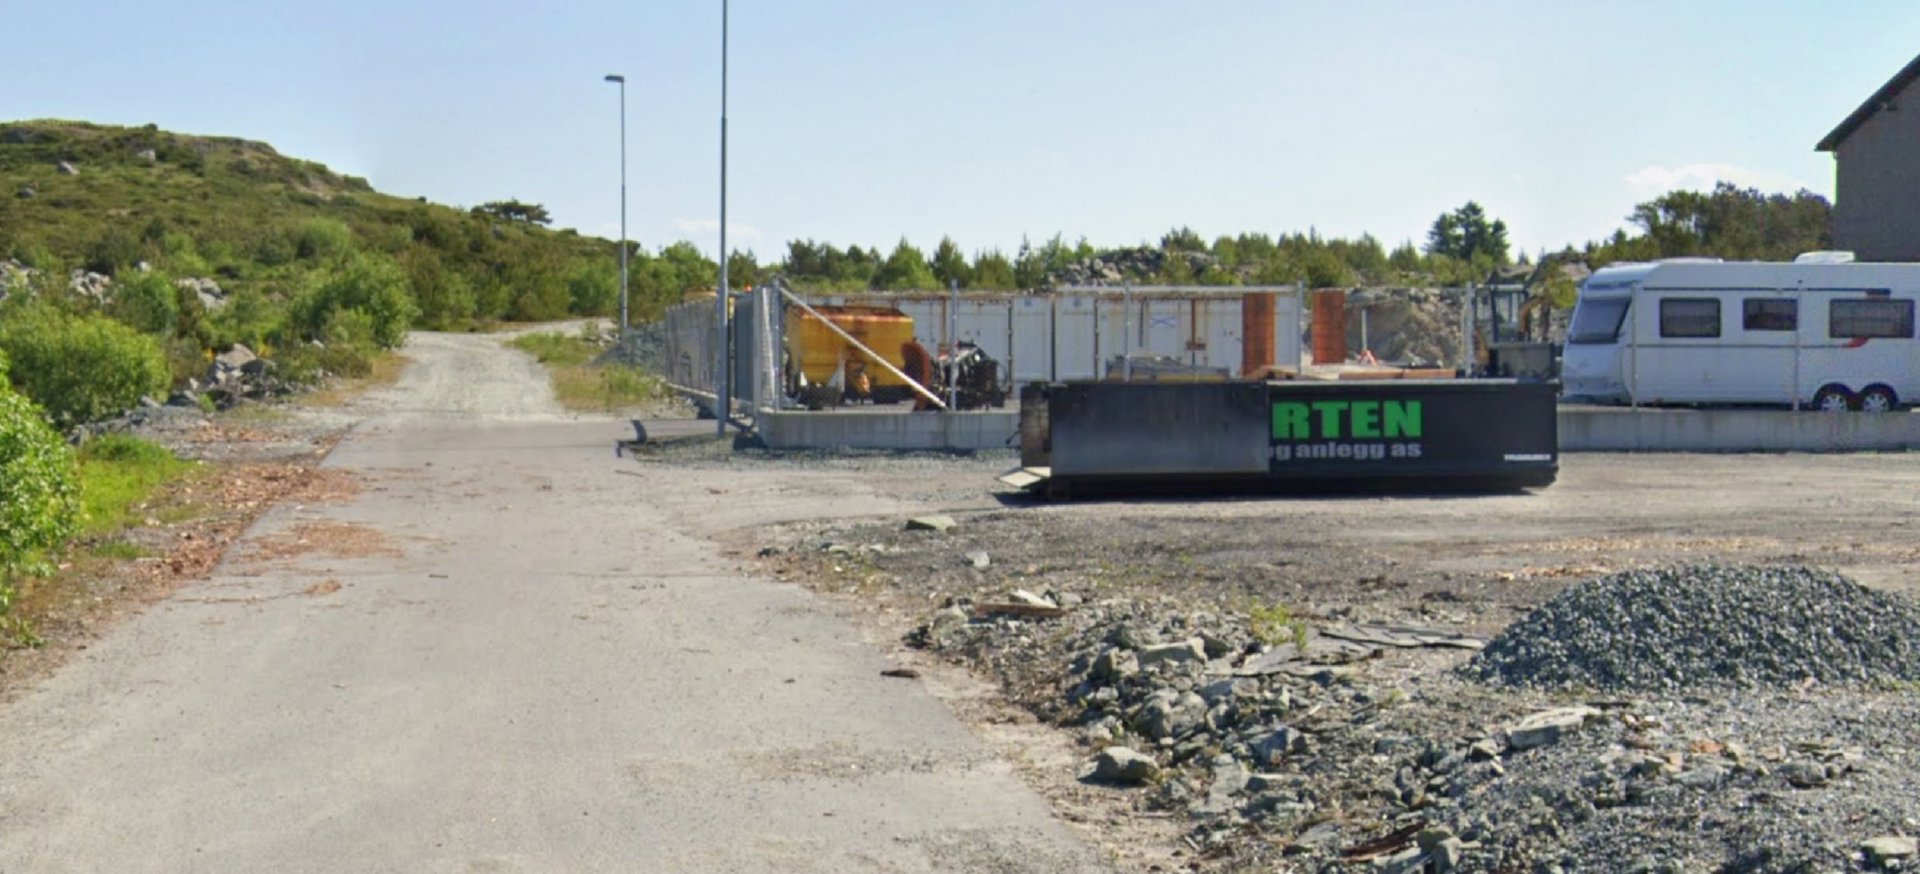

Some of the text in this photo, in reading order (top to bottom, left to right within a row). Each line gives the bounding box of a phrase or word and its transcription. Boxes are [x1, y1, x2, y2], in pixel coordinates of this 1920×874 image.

[1272, 401, 1422, 438] RTEN
[1296, 442, 1385, 460] anlegg
[1391, 443, 1422, 458] as
